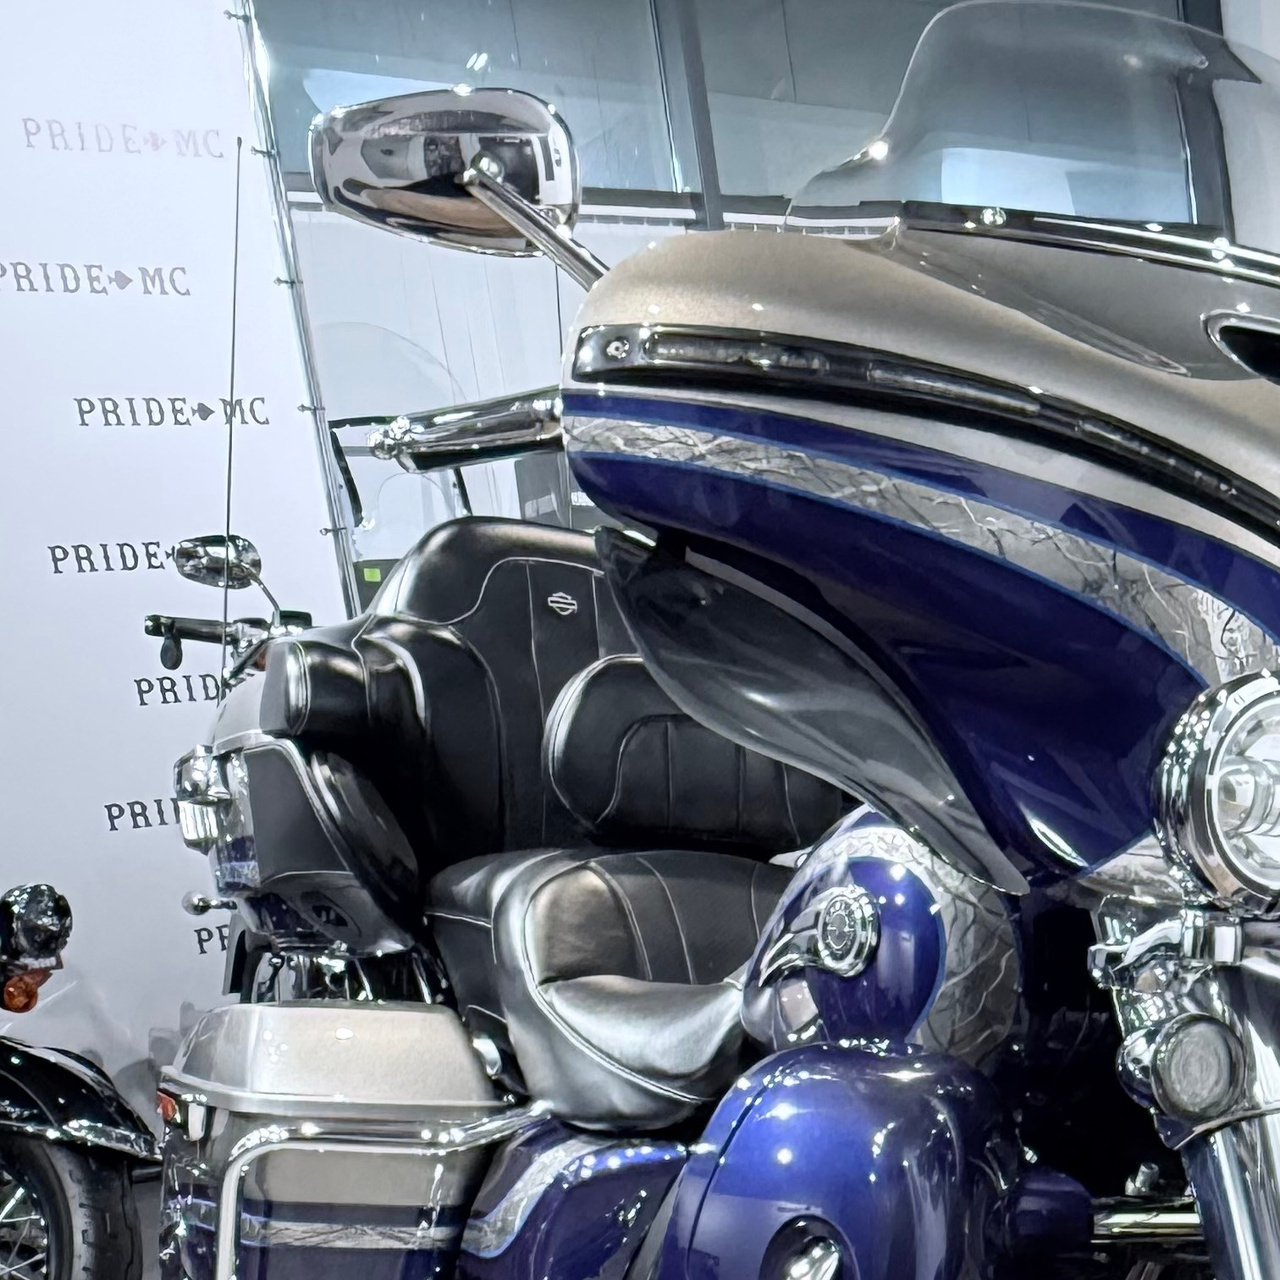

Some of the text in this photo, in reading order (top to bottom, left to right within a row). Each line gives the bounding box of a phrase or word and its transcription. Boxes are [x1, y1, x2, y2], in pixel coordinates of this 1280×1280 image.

[21, 117, 224, 158] PRIDE MC
[137, 266, 191, 296] MC
[73, 397, 270, 427] PRIDE MC
[47, 541, 166, 574] PRIDE
[133, 673, 228, 706] PRID
